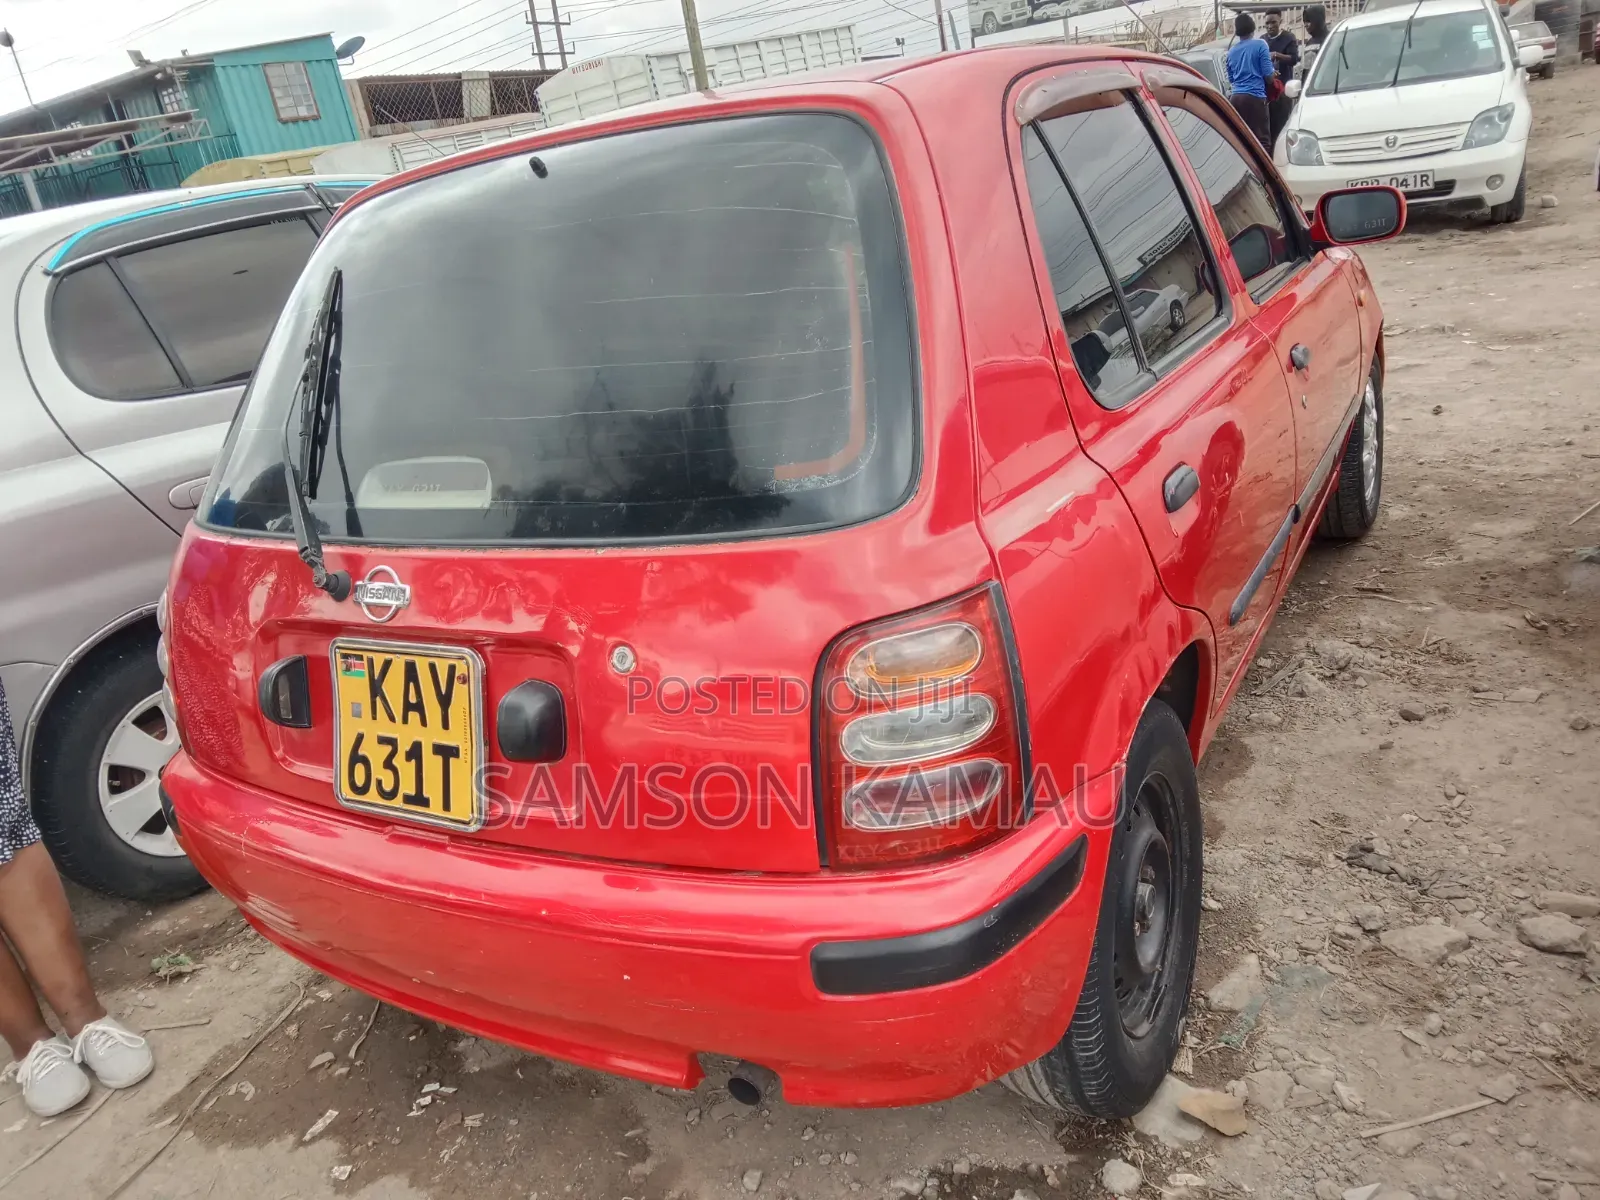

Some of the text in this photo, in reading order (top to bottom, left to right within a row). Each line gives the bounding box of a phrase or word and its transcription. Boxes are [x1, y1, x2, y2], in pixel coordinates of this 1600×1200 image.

[1389, 174, 1431, 189] 041R
[357, 584, 403, 603] NISSAN
[366, 656, 457, 731] KAY
[347, 732, 461, 812] 631T
